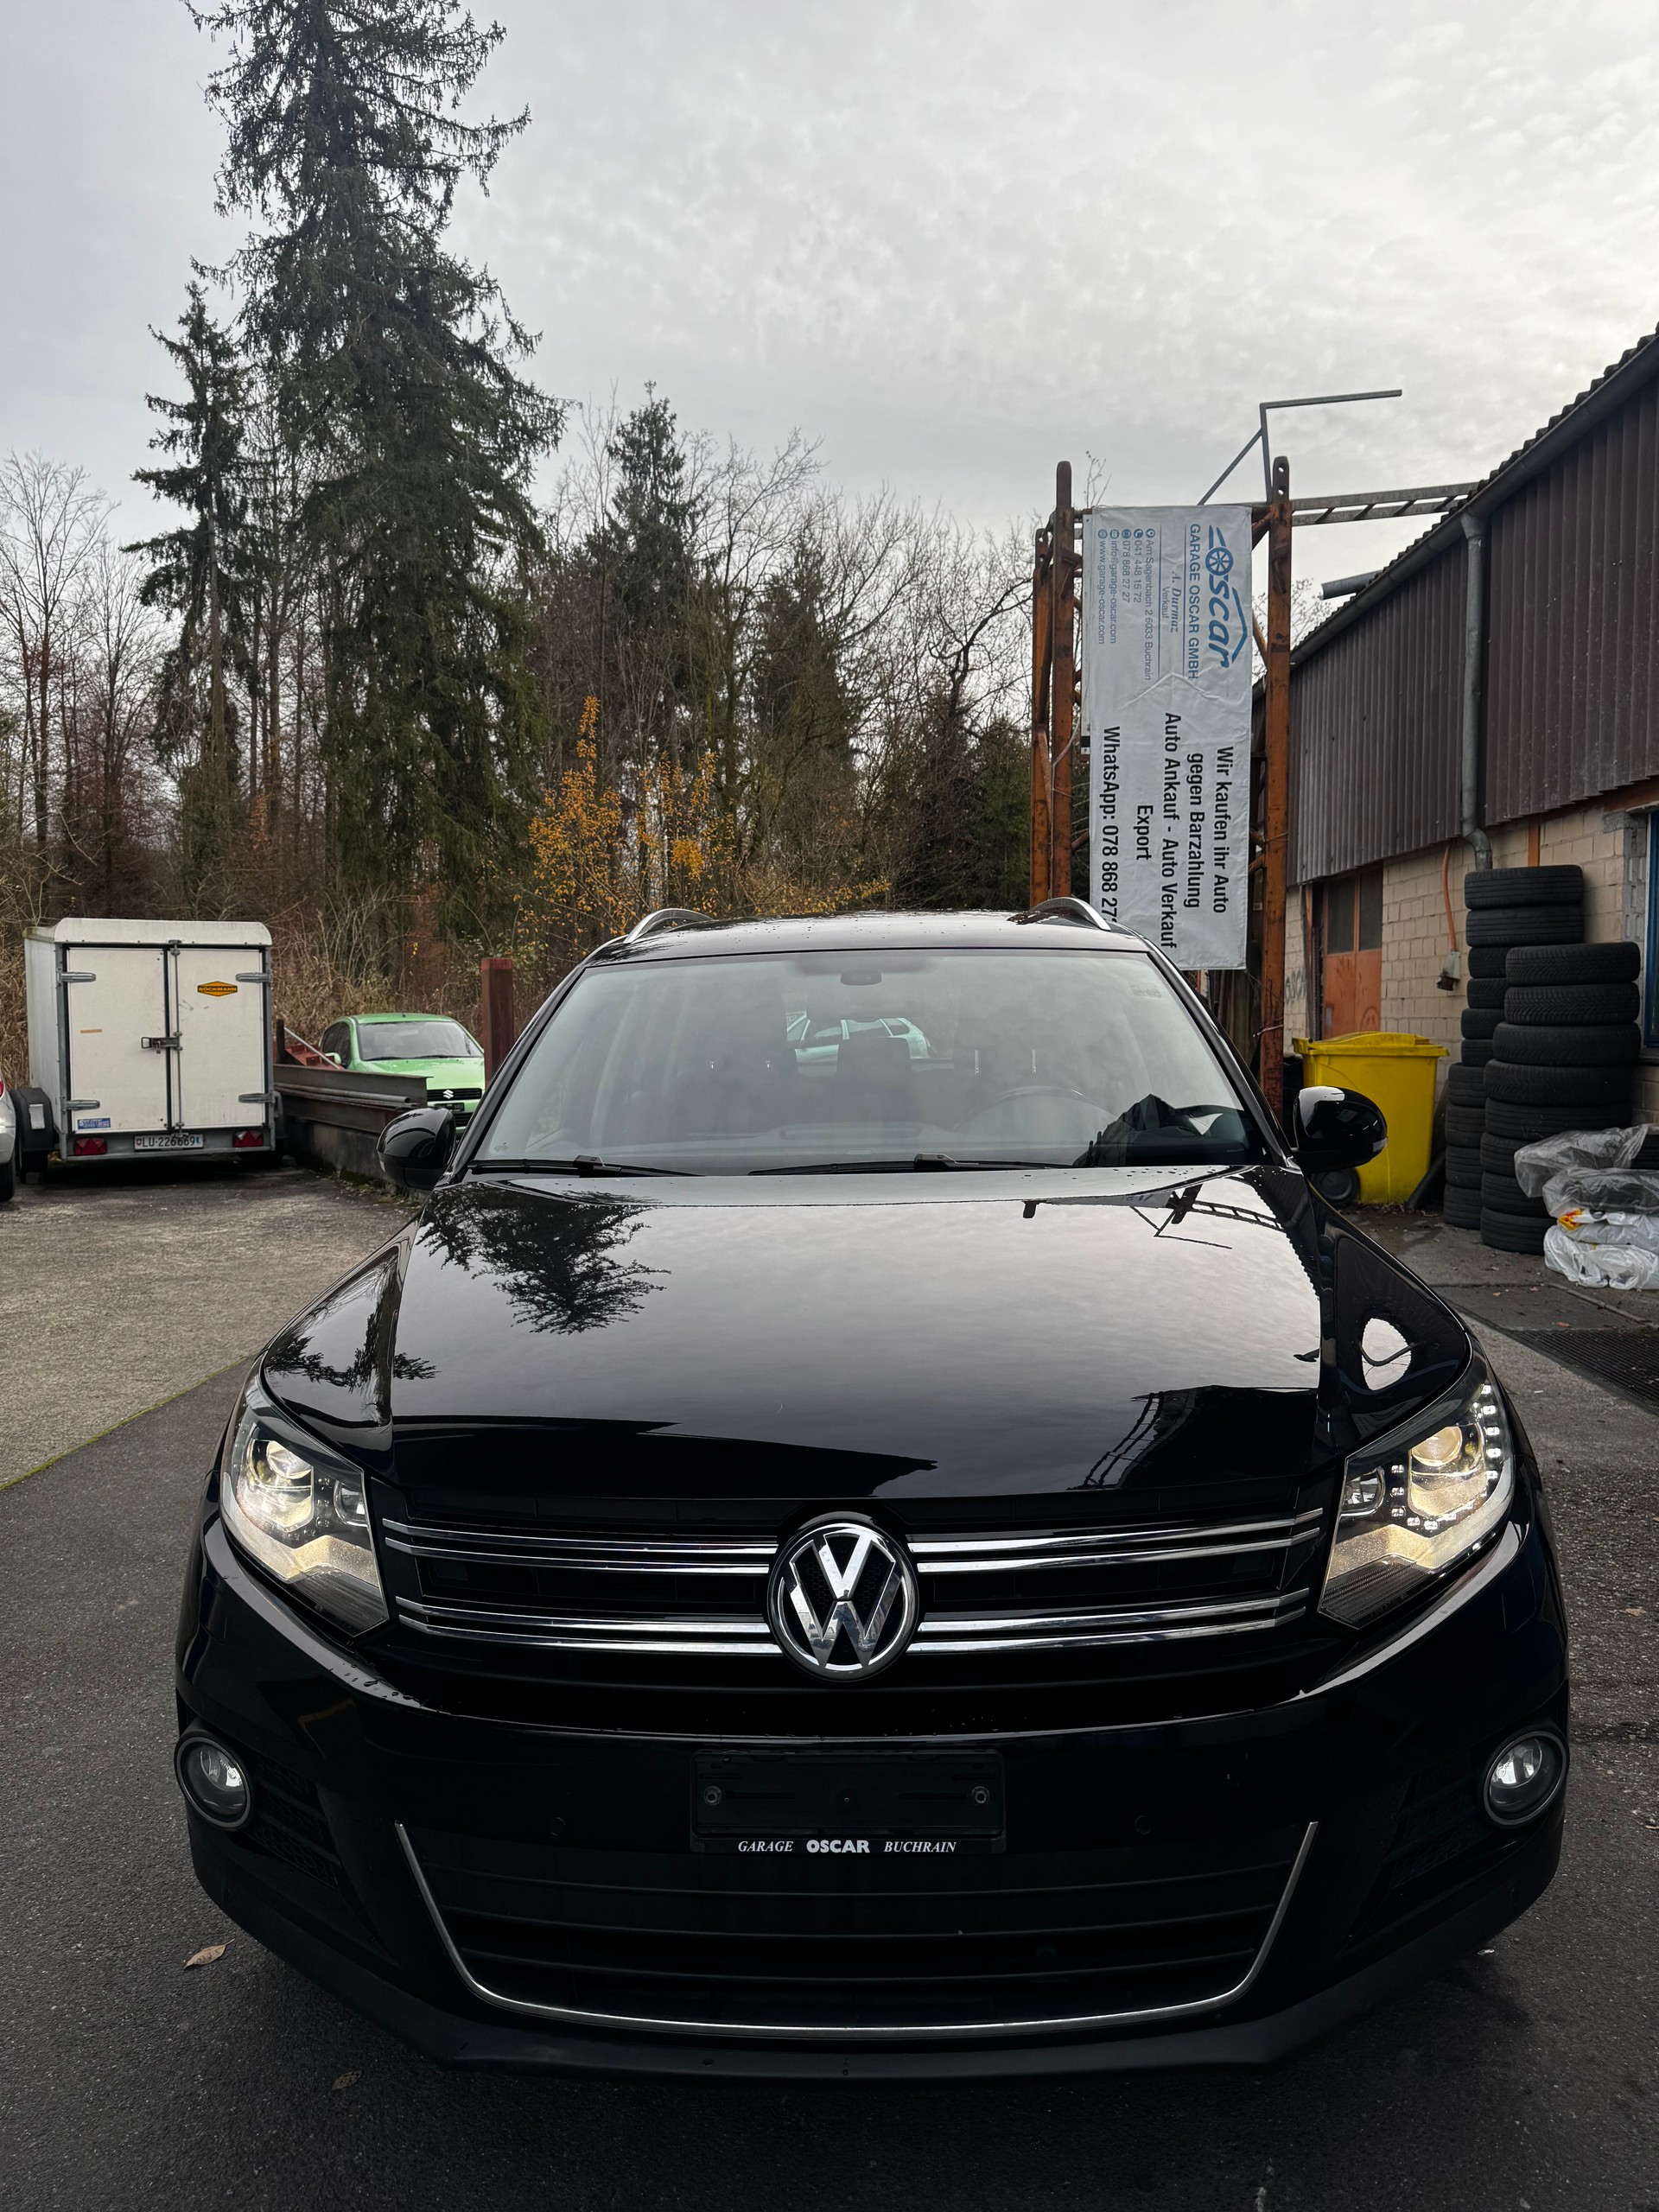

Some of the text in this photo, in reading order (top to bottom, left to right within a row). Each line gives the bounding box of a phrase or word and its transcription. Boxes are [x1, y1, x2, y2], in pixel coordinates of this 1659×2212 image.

[1122, 540, 1131, 557] 078
[1134, 540, 1142, 556] 041
[1145, 539, 1154, 556] Am
[1097, 541, 1106, 645] www.garage-oscar.com
[1109, 541, 1118, 644] info@garage-oscar.com
[1122, 579, 1130, 589] 27
[1122, 593, 1130, 603] 27
[1133, 590, 1141, 603] 72
[1134, 579, 1141, 589] 15
[1161, 586, 1170, 619] Verkauf
[1170, 571, 1182, 633] A. Durmaz
[1188, 523, 1201, 679] GARAGE OSCAR GMBH
[1145, 619, 1154, 640] 6033
[1144, 642, 1154, 681] Buchrain
[1165, 712, 1181, 752] Auto
[1163, 758, 1180, 820] Ankauf
[1099, 726, 1120, 923] WhatsApp: 078 868 27
[1133, 804, 1154, 861] Export
[1184, 753, 1205, 907] gegen Barzahlung
[1213, 746, 1234, 913] Wir kaufen ihr Auto
[1161, 838, 1179, 878] Auto
[1160, 882, 1178, 949] Verkauf
[738, 1840, 957, 1853] GARAGE OSCAR BUCHRAIN
